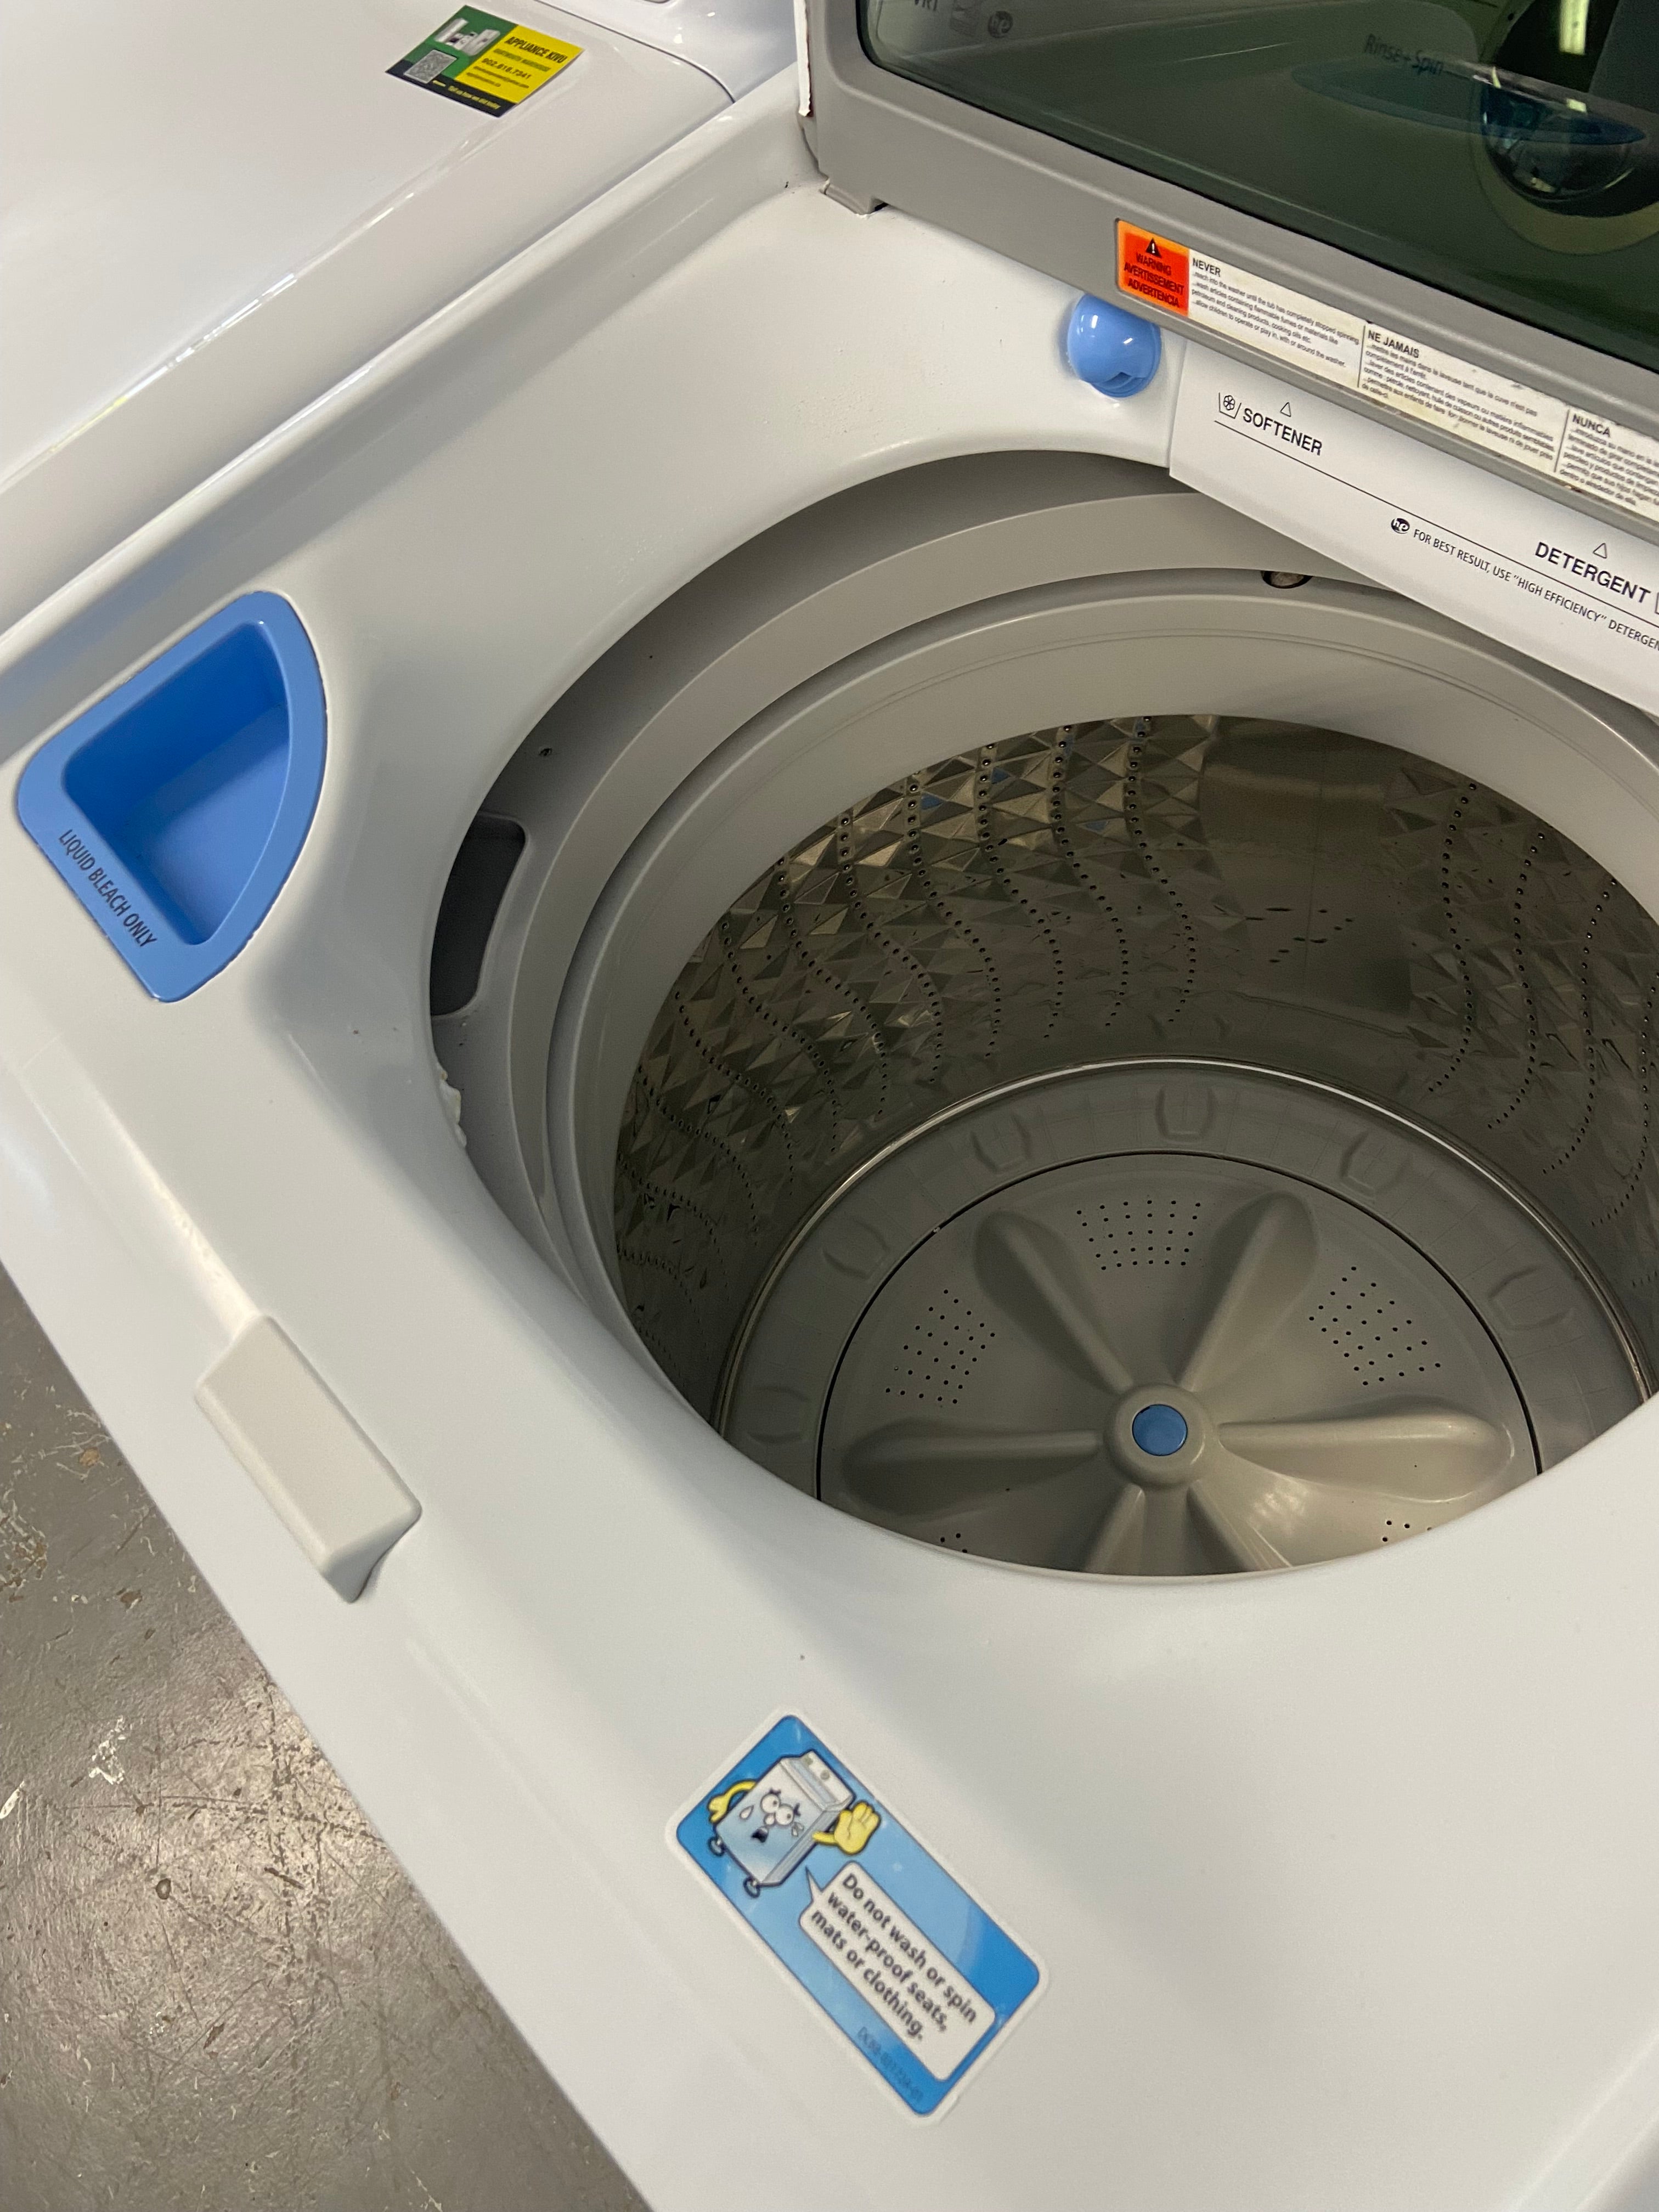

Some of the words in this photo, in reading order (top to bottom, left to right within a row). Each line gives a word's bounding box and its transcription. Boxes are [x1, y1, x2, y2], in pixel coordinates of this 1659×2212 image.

[504, 36, 550, 57] APPLIANCE
[1124, 263, 1184, 295] AVERTISSEMENT
[1136, 253, 1171, 276] WARNING
[1193, 258, 1221, 276] NEVER
[1128, 278, 1180, 308] ADVERTENCIA
[1228, 295, 1252, 311] containing
[1228, 286, 1245, 296] washer
[1257, 297, 1266, 305] the
[1286, 310, 1314, 326] completely
[1234, 317, 1253, 328] operate
[1368, 330, 1380, 342] NE
[1383, 337, 1419, 358] JAMAIS
[1243, 408, 1322, 456] SOFTENER
[1572, 414, 1610, 437] NUNCA
[1535, 541, 1651, 603] DETERGENT
[1413, 529, 1431, 544] FOR
[1433, 538, 1455, 555] BEST
[1457, 549, 1490, 573] RESULT,
[1493, 566, 1511, 582] USE
[1609, 620, 1659, 651] DETERGEN
[59, 830, 95, 871] LIQUID
[88, 867, 131, 917] BLEACH
[123, 913, 157, 947] ONLY
[828, 1893, 913, 1983] water-proof
[907, 1982, 947, 2033] seats,
[842, 1873, 864, 1899] Do
[864, 1898, 891, 1929] not
[890, 1926, 926, 1969] wash
[927, 1968, 945, 1987] or
[943, 1985, 977, 2023] spin
[811, 1911, 847, 1950] mats
[847, 1950, 866, 1969] or
[864, 1968, 923, 2041] clothing.
